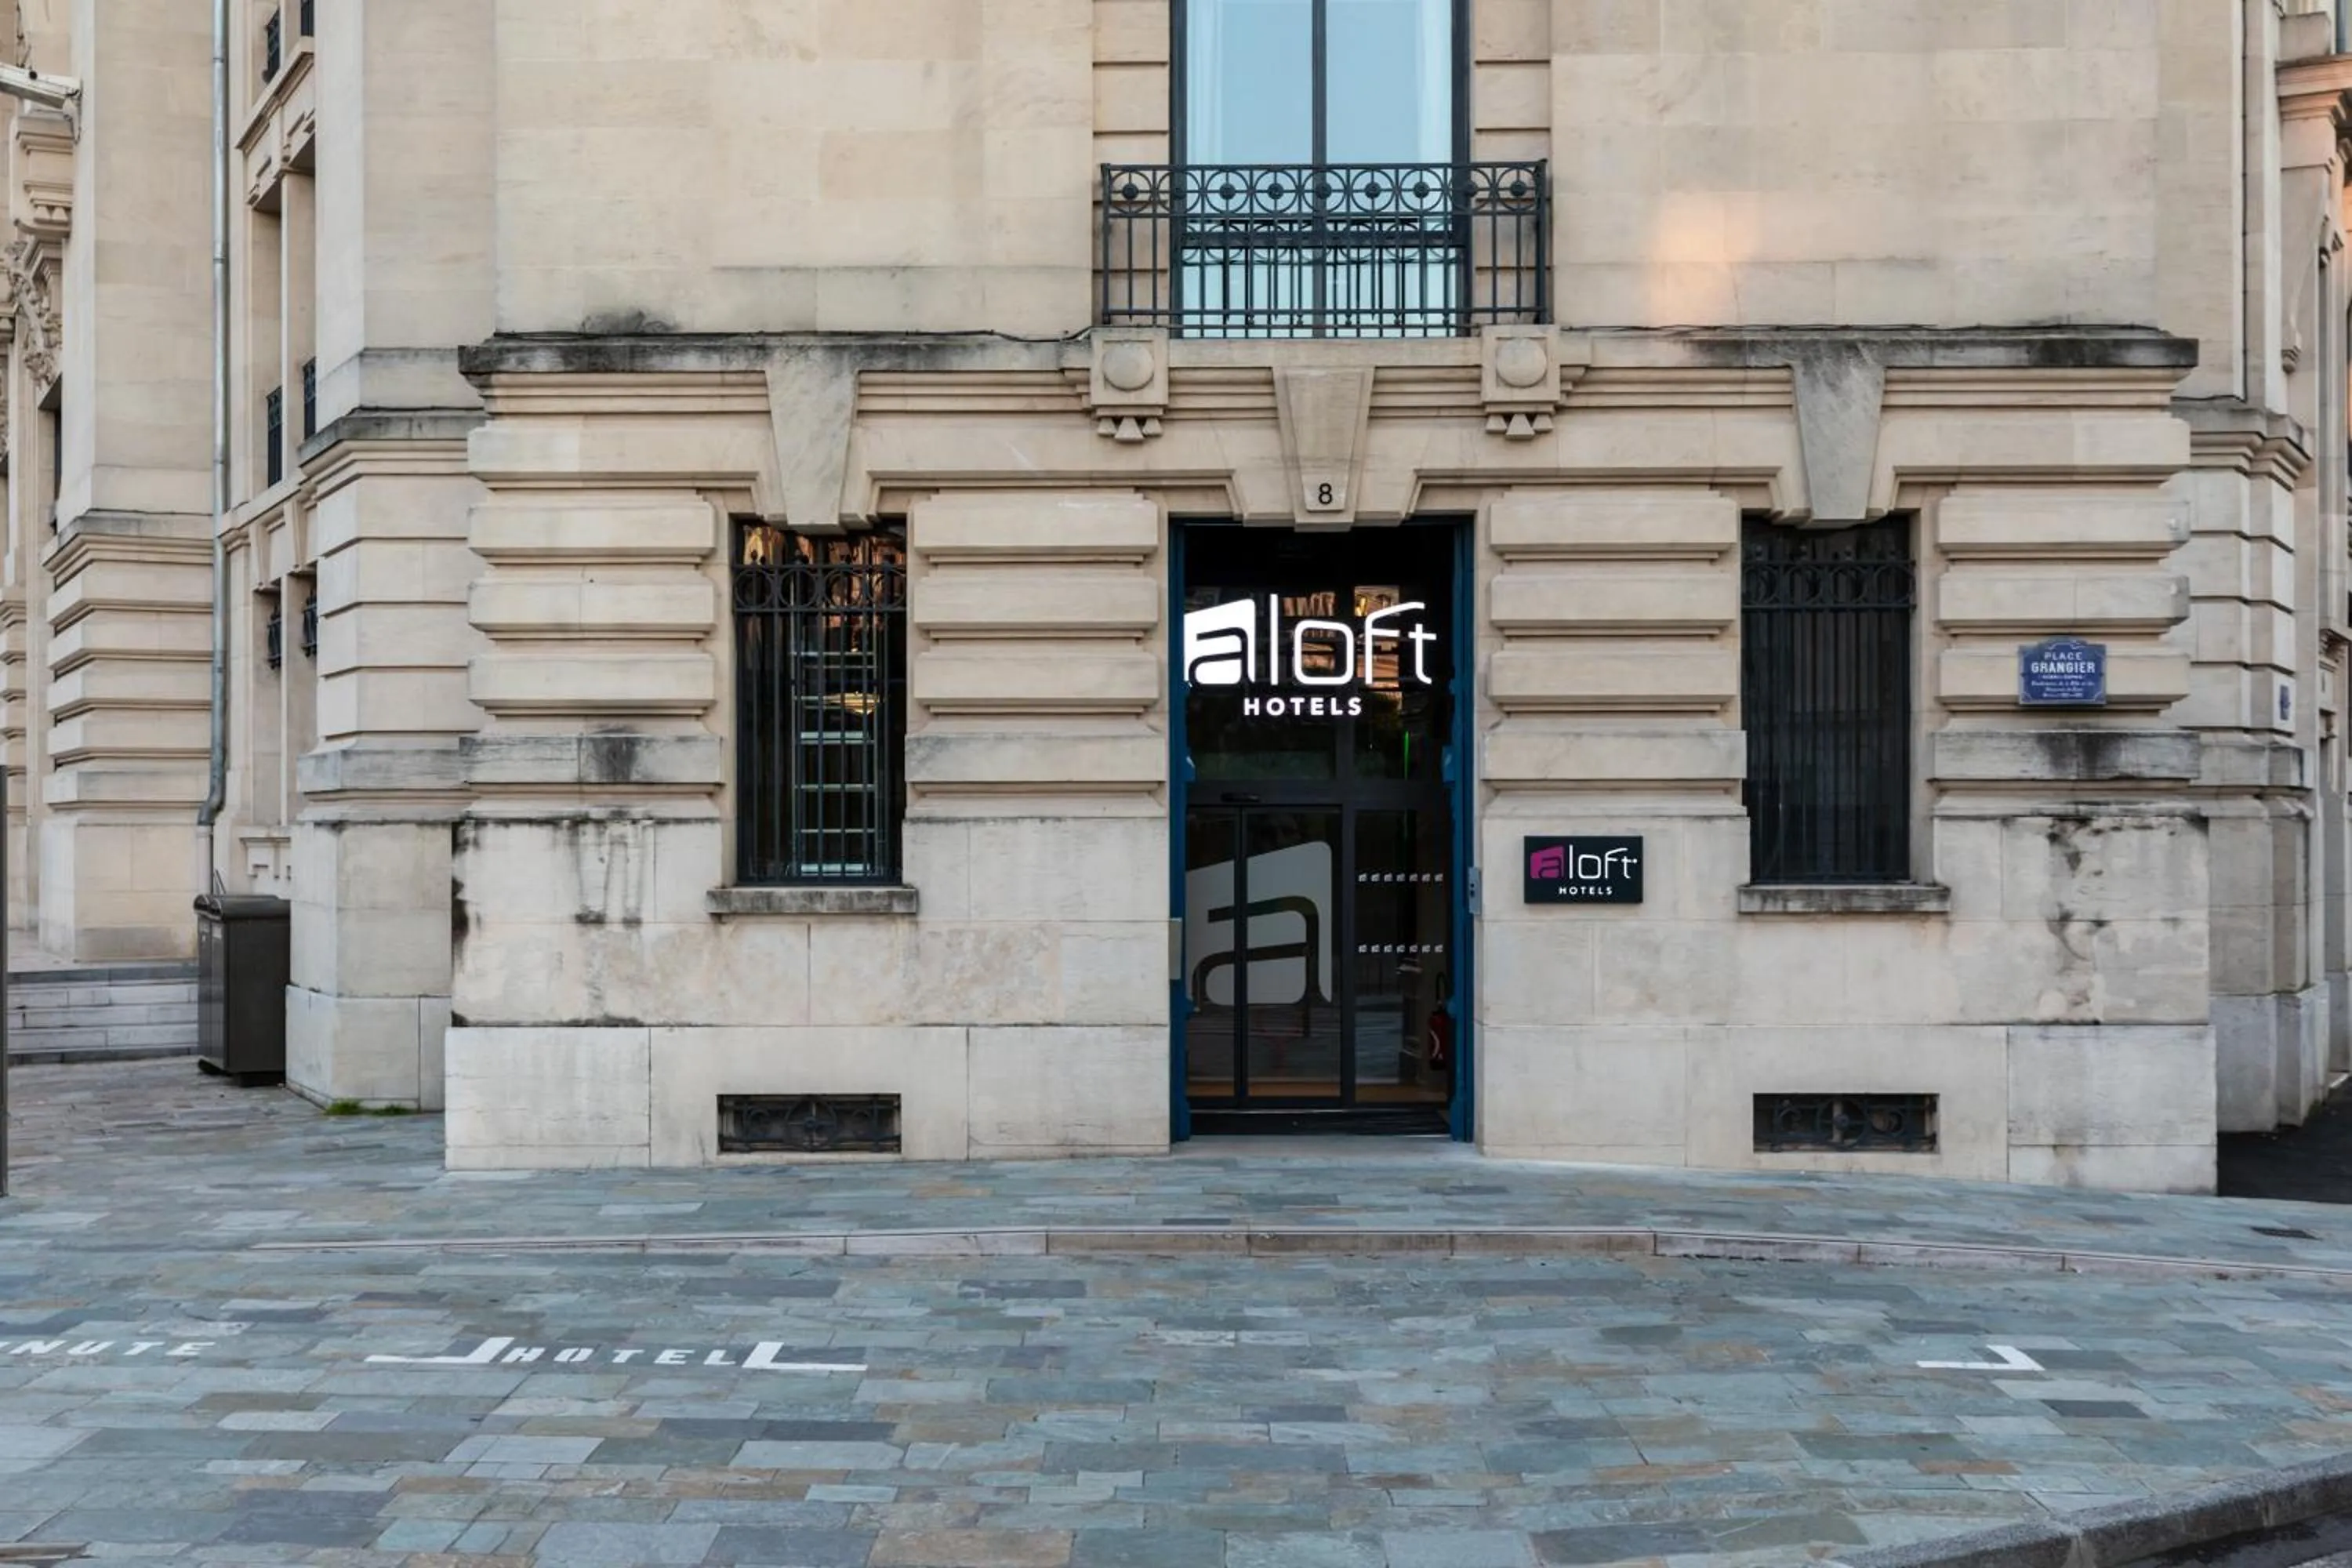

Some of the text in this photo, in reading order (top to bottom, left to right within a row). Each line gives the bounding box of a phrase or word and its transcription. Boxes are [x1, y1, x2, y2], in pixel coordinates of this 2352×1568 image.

[1319, 482, 1333, 505] 8
[1184, 593, 1436, 685] aloft
[2044, 652, 2083, 661] PLACE
[2031, 662, 2096, 673] GRANGIER
[1243, 697, 1362, 715] HOTELS
[1530, 844, 1637, 879] aloft
[1558, 886, 1613, 895] HOTELS
[501, 1347, 737, 1365] HOTEL
